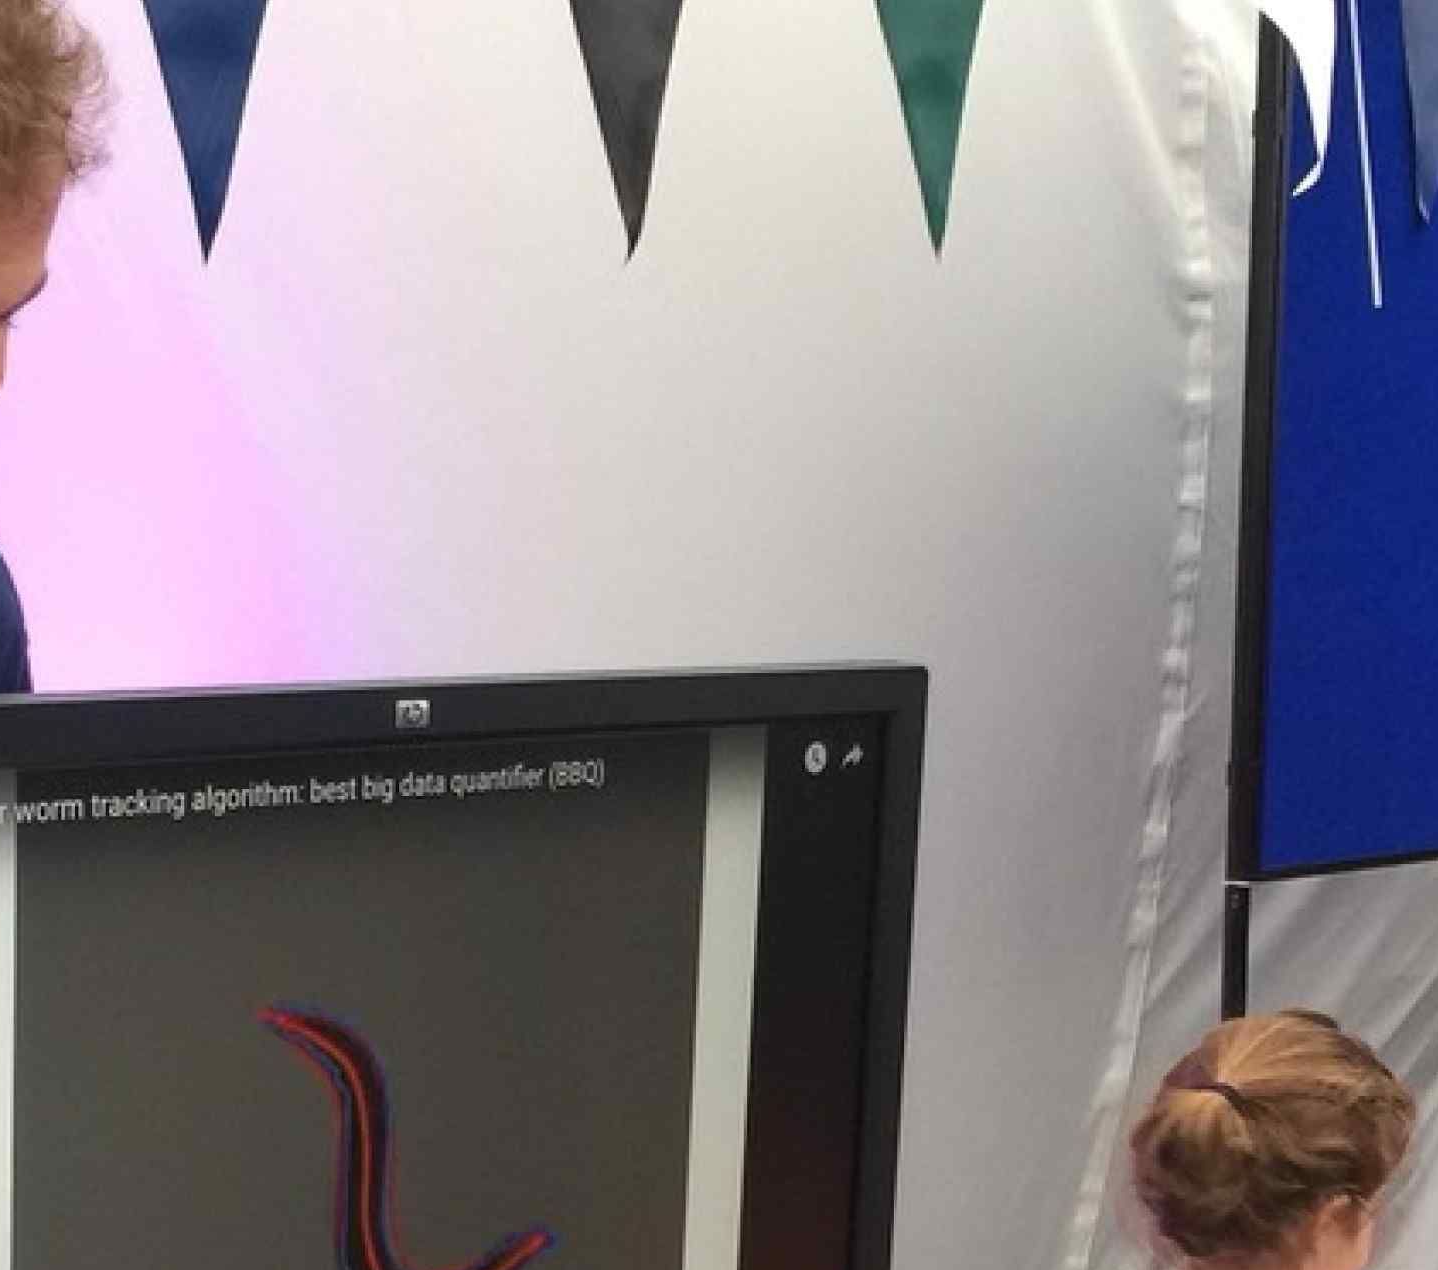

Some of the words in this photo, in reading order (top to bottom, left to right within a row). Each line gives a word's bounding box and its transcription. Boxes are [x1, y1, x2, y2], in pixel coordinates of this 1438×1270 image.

[14, 799, 82, 823] worm
[92, 788, 185, 820] tracking
[191, 779, 305, 816] algorithm:
[310, 776, 356, 803] best
[361, 775, 393, 803] big
[398, 771, 446, 797] data
[450, 762, 545, 800] quantifier
[549, 758, 604, 791] (BBQ)
